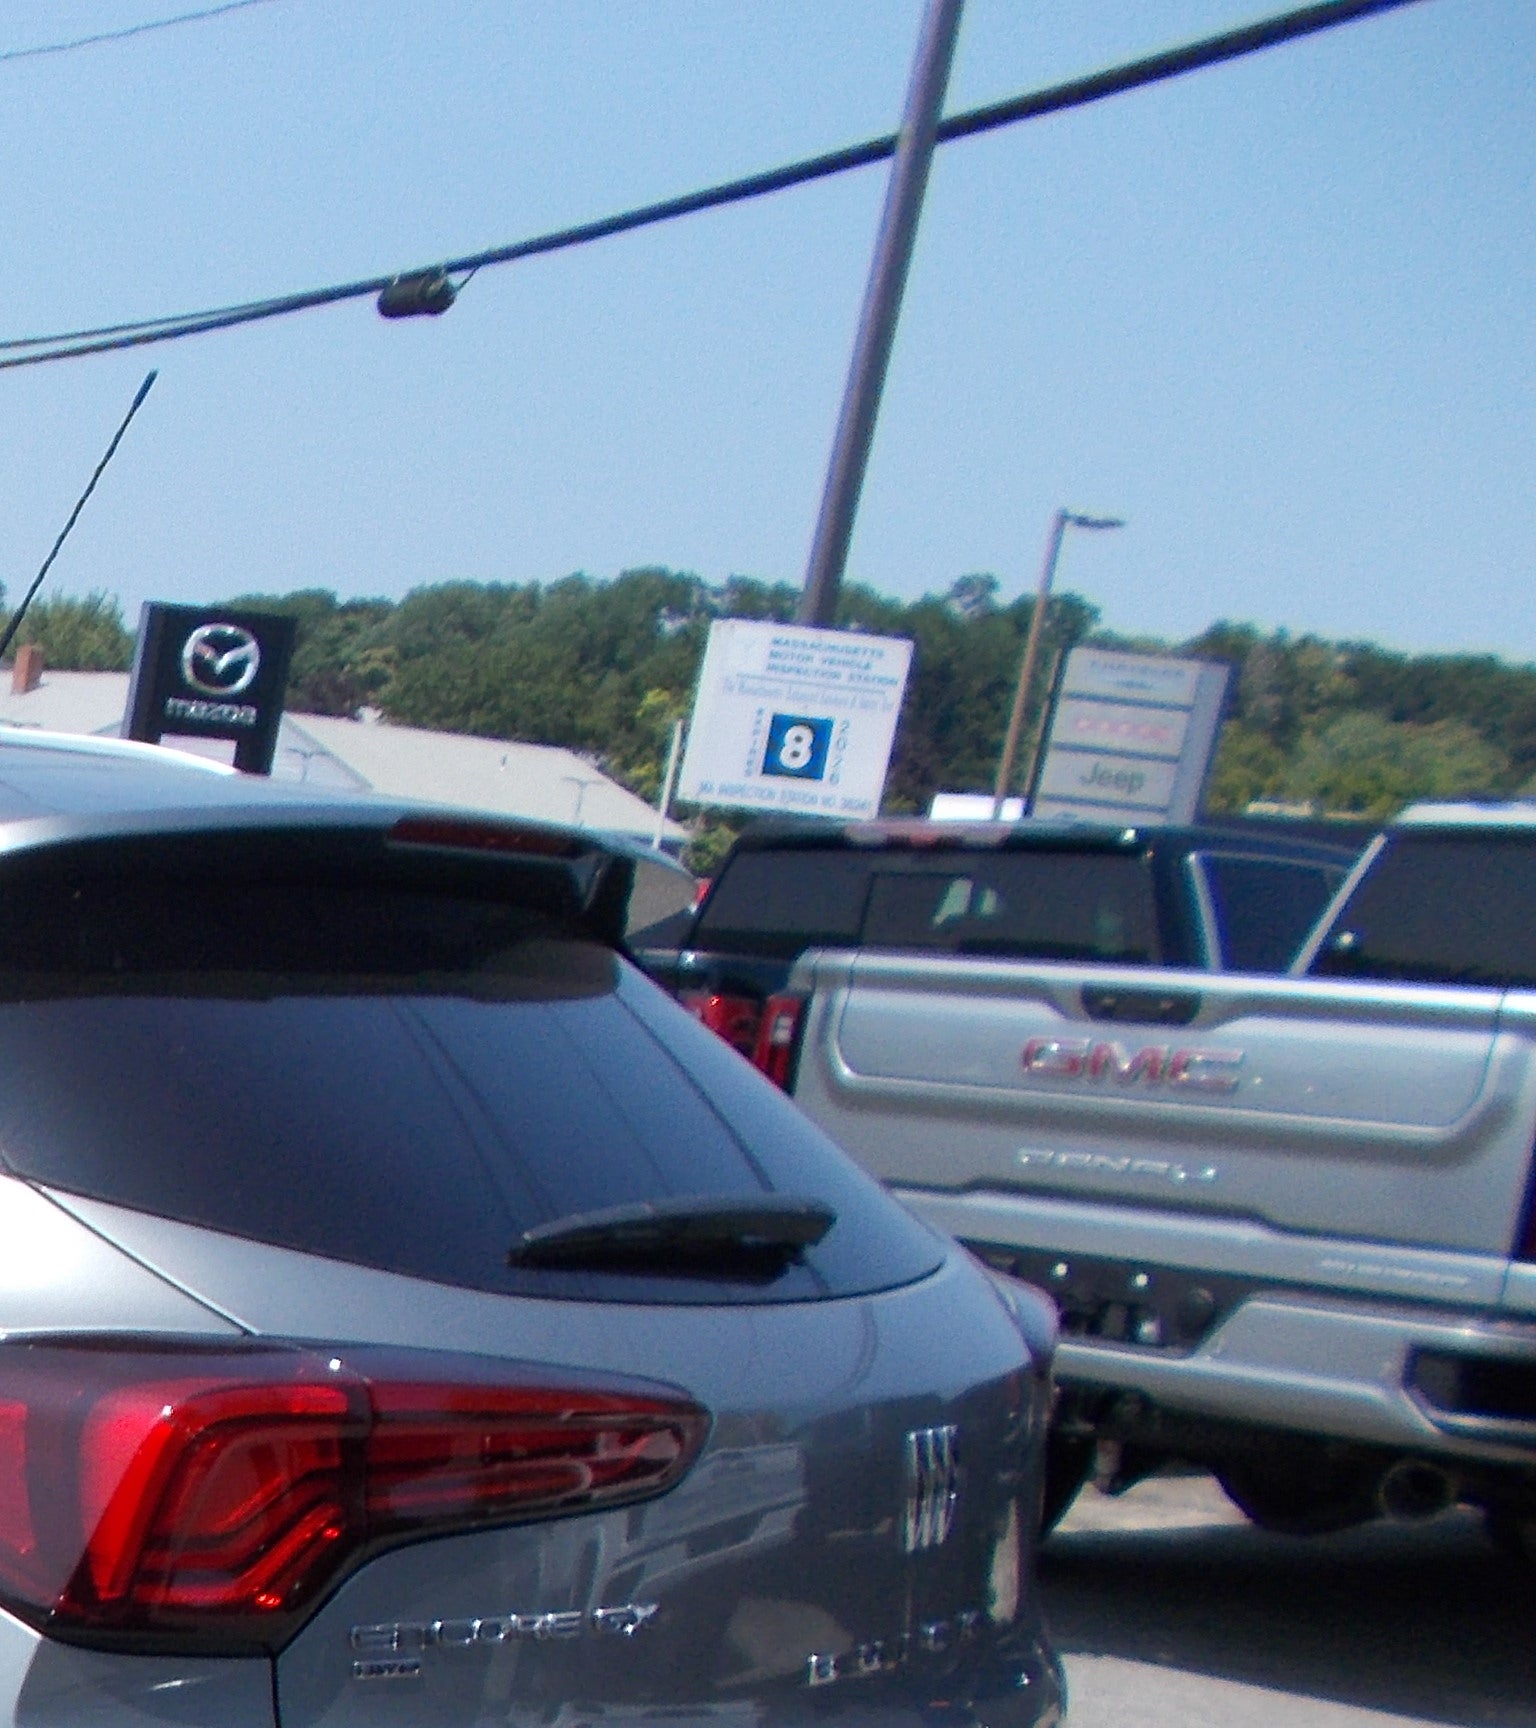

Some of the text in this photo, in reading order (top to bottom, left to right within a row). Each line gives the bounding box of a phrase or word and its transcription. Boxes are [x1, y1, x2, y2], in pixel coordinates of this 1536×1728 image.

[779, 724, 815, 769] 8
[1079, 761, 1146, 793] Jeep
[1022, 1037, 1245, 1091] GMC
[350, 1610, 581, 1650] ENCORE
